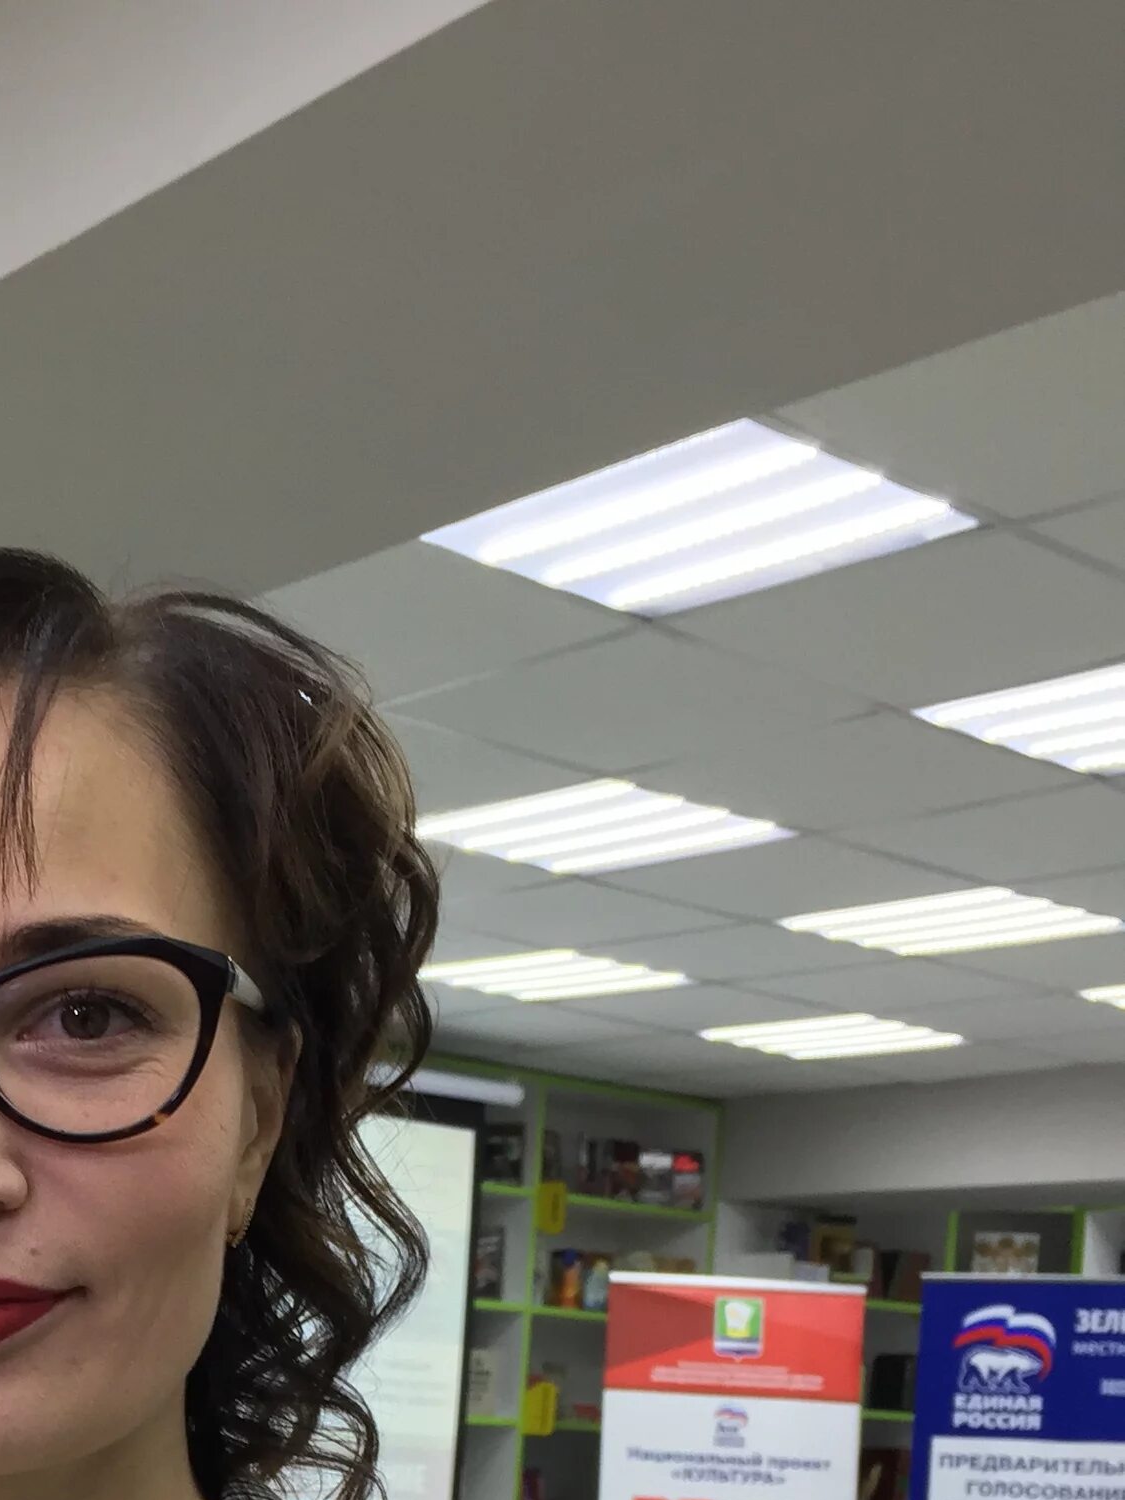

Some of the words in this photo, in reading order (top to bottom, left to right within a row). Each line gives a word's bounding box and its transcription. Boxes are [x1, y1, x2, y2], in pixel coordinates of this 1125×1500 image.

[953, 1393, 1043, 1412] ЕДИНАЯ
[952, 1411, 1042, 1431] РОССИЯ
[626, 1446, 763, 1467] Национальный
